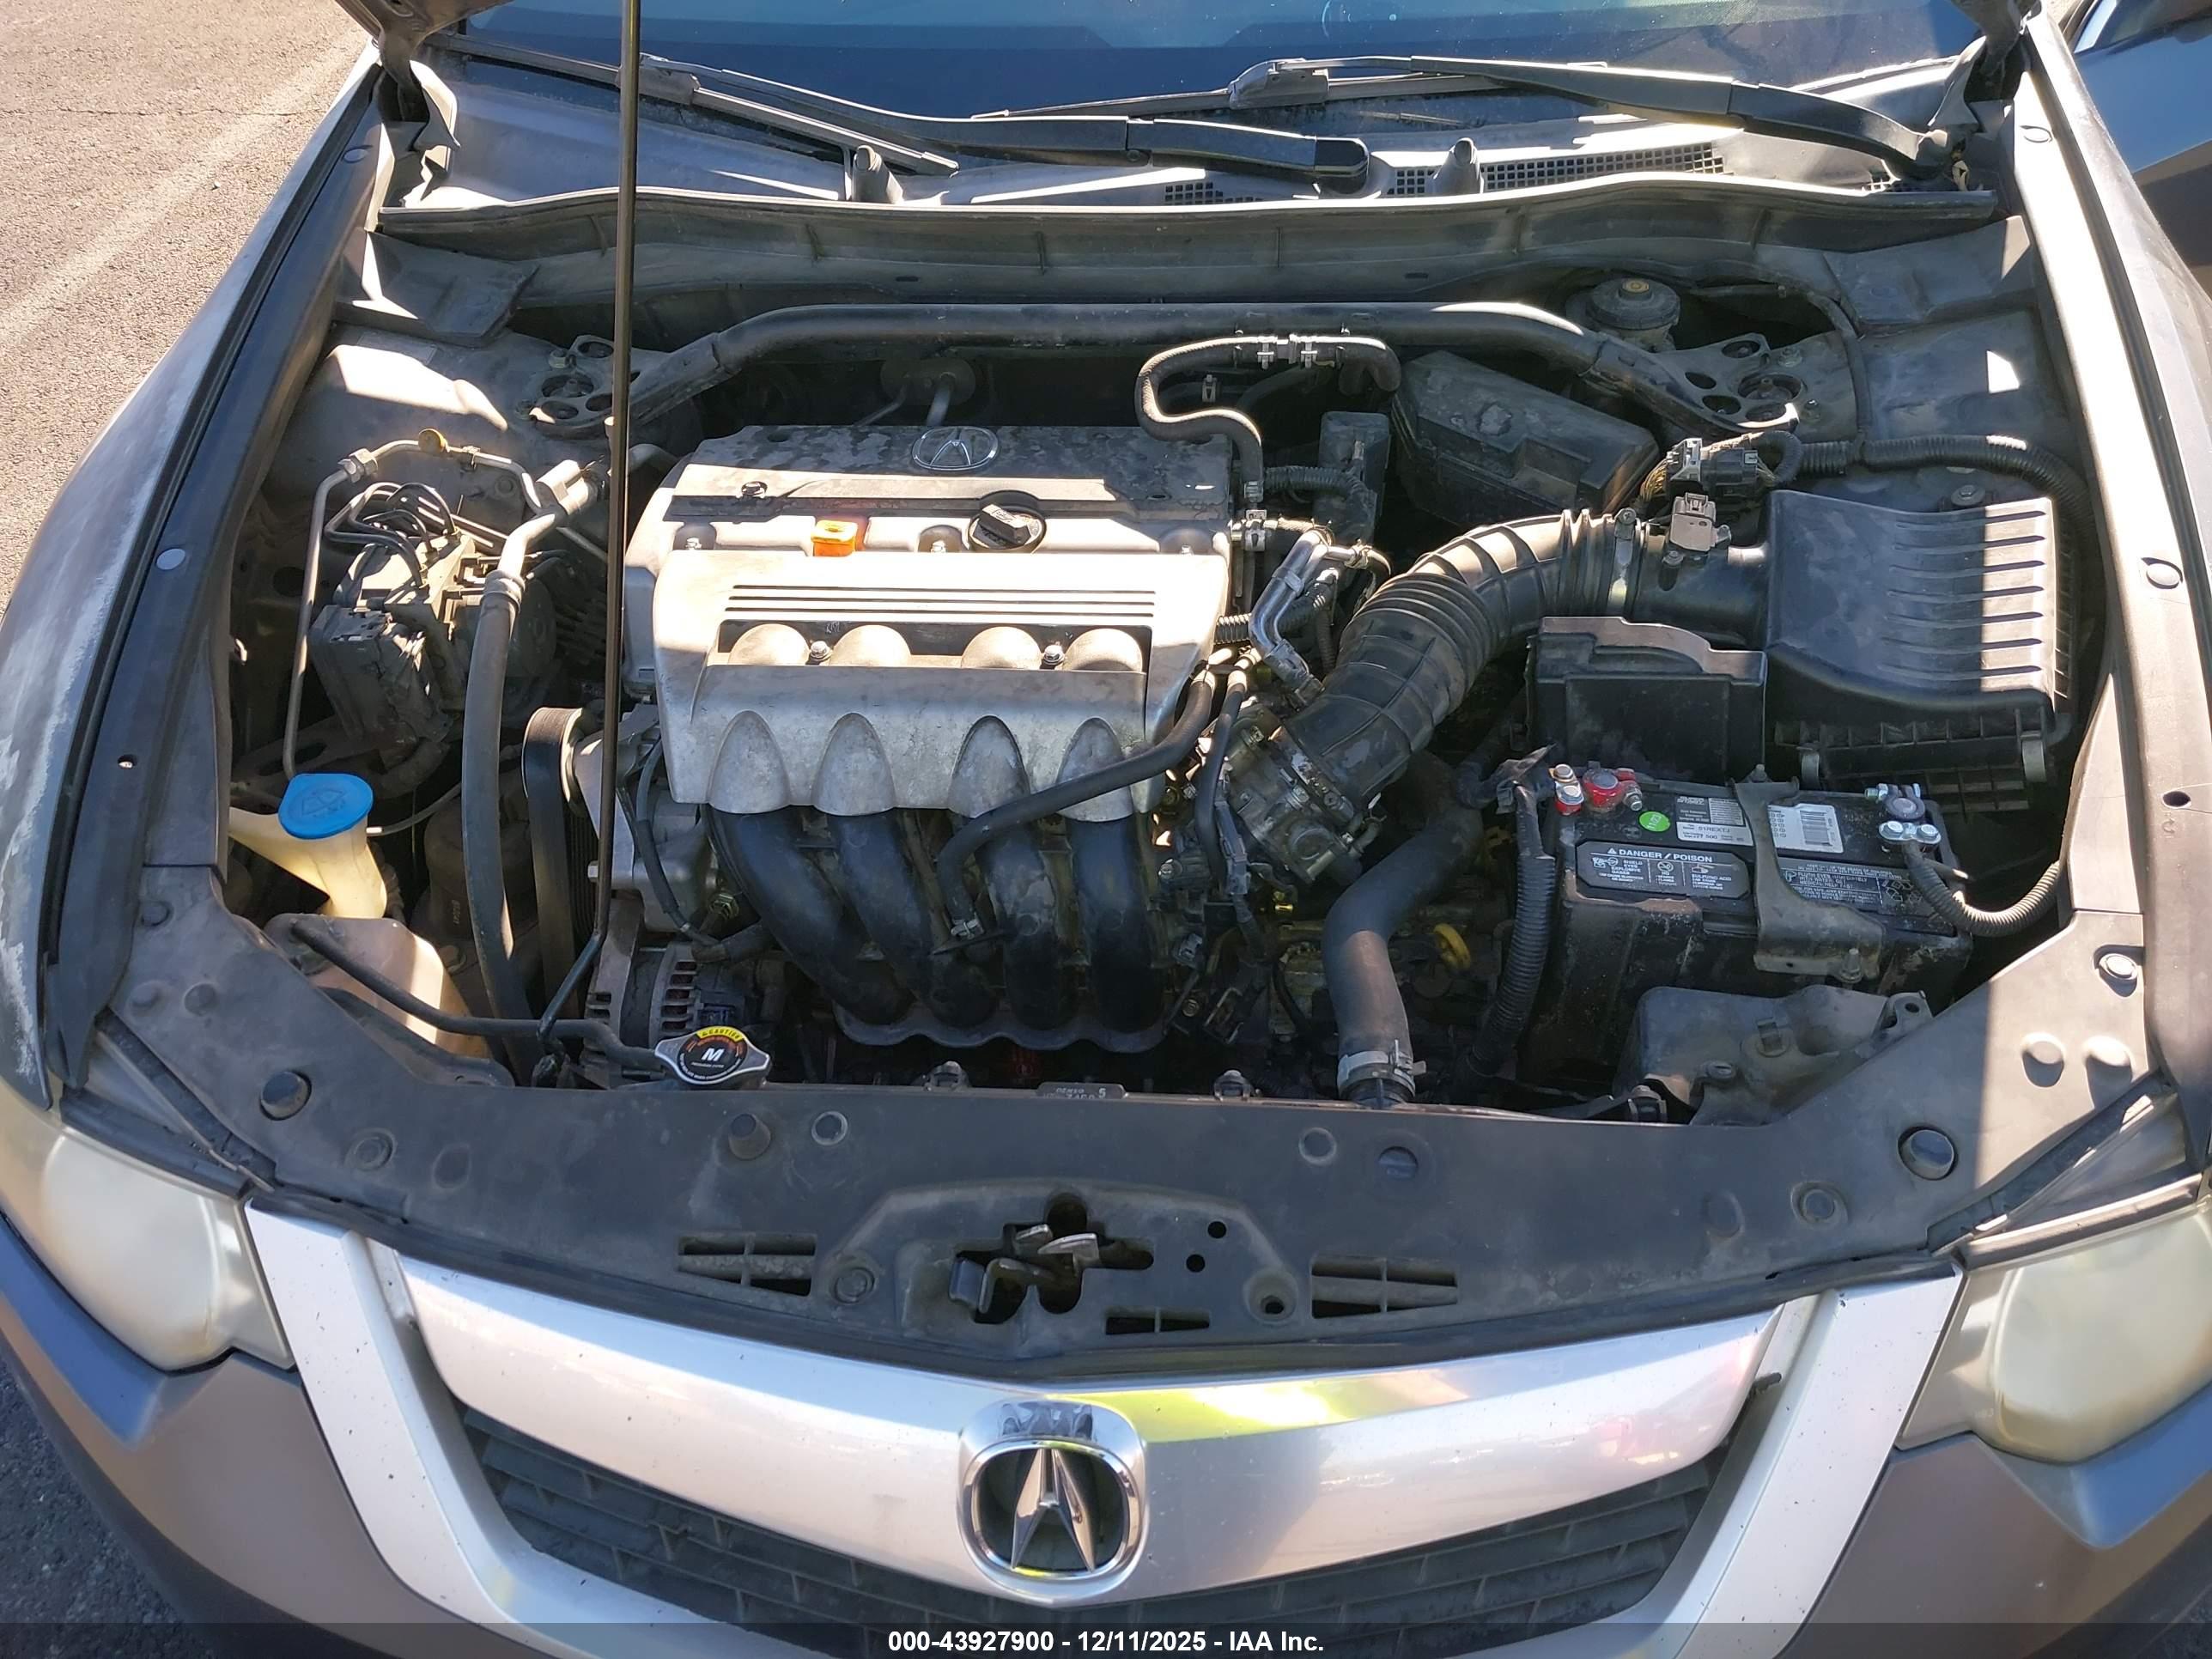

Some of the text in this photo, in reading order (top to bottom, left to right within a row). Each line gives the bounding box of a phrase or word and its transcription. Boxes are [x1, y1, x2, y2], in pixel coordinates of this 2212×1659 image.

[1619, 848, 1662, 859] DANGER
[1674, 854, 1712, 863] POISON
[708, 1029, 740, 1040] CAUTION
[701, 1048, 725, 1061] M
